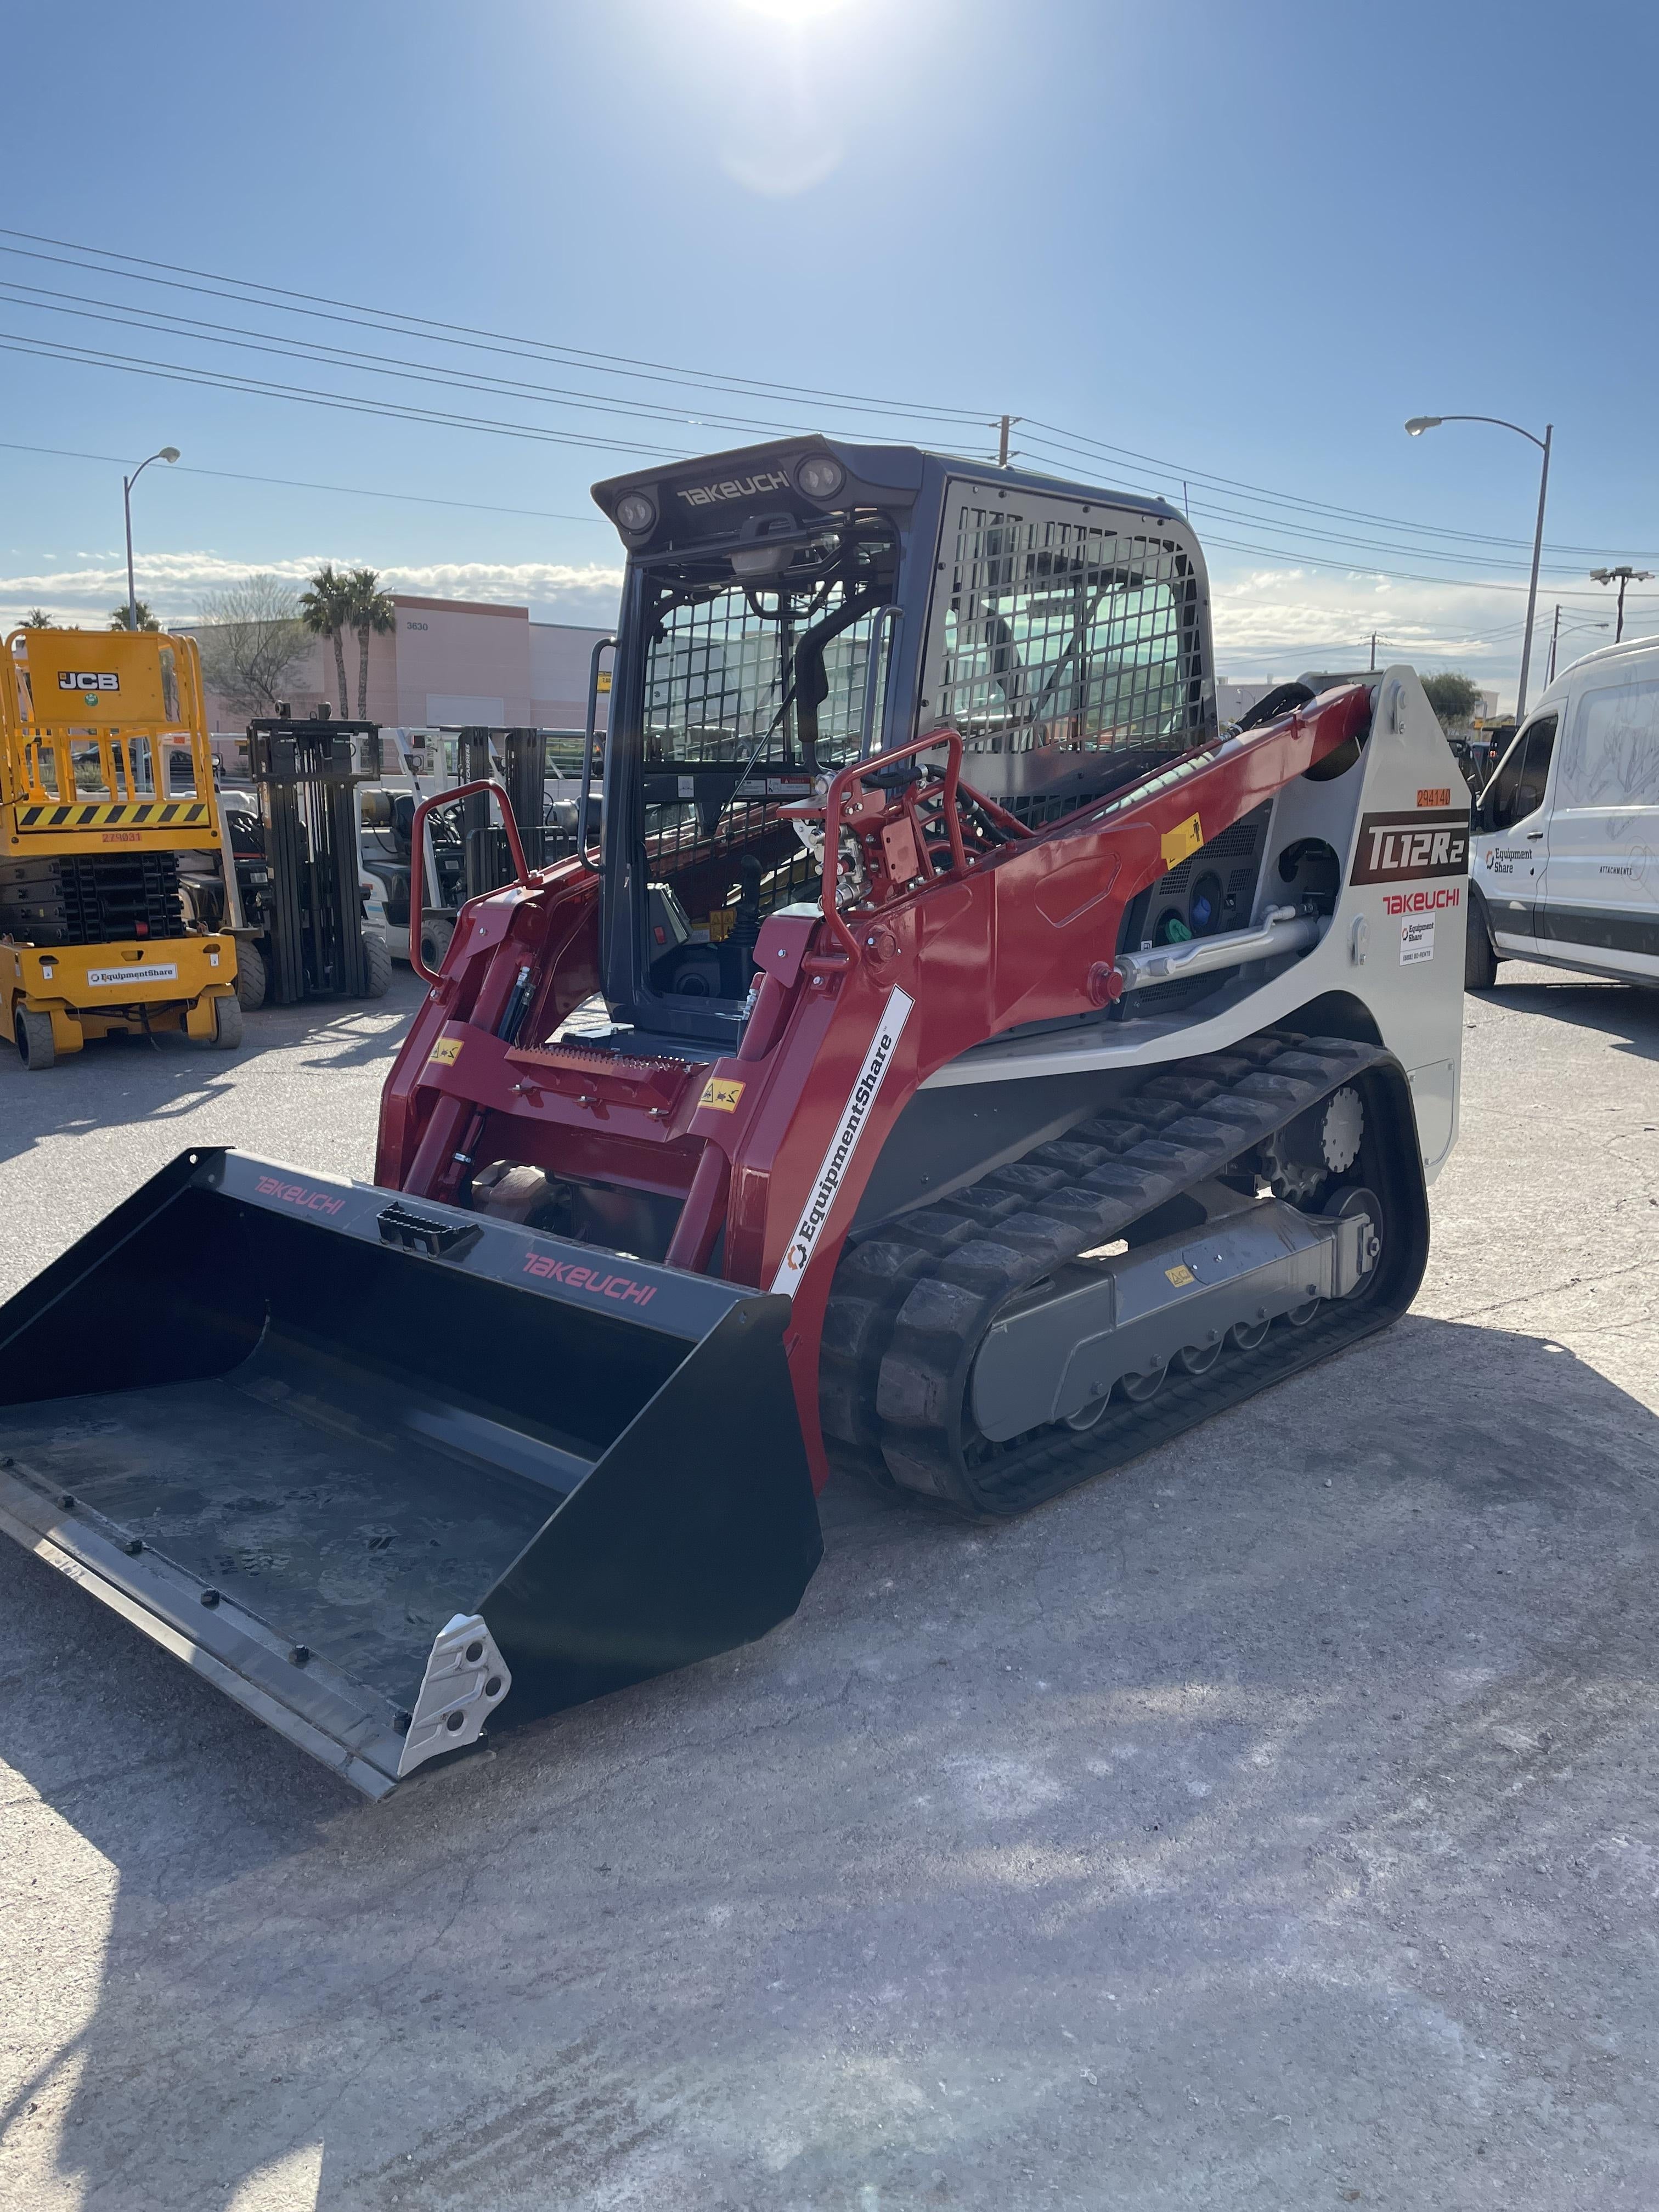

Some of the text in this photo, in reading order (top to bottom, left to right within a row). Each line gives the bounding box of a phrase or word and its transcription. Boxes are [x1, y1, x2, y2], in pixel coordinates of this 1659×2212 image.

[407, 622, 428, 631] 3630
[59, 673, 119, 690] JCB
[1418, 788, 1451, 807] 294140
[1495, 848, 1532, 861] Equipment
[1494, 861, 1513, 873] Share
[1599, 866, 1632, 875] ATTACHMENTS
[1409, 922, 1434, 934] Equipment
[101, 969, 173, 981] EquipmentShare
[799, 1034, 892, 1242] EquipmentShare
